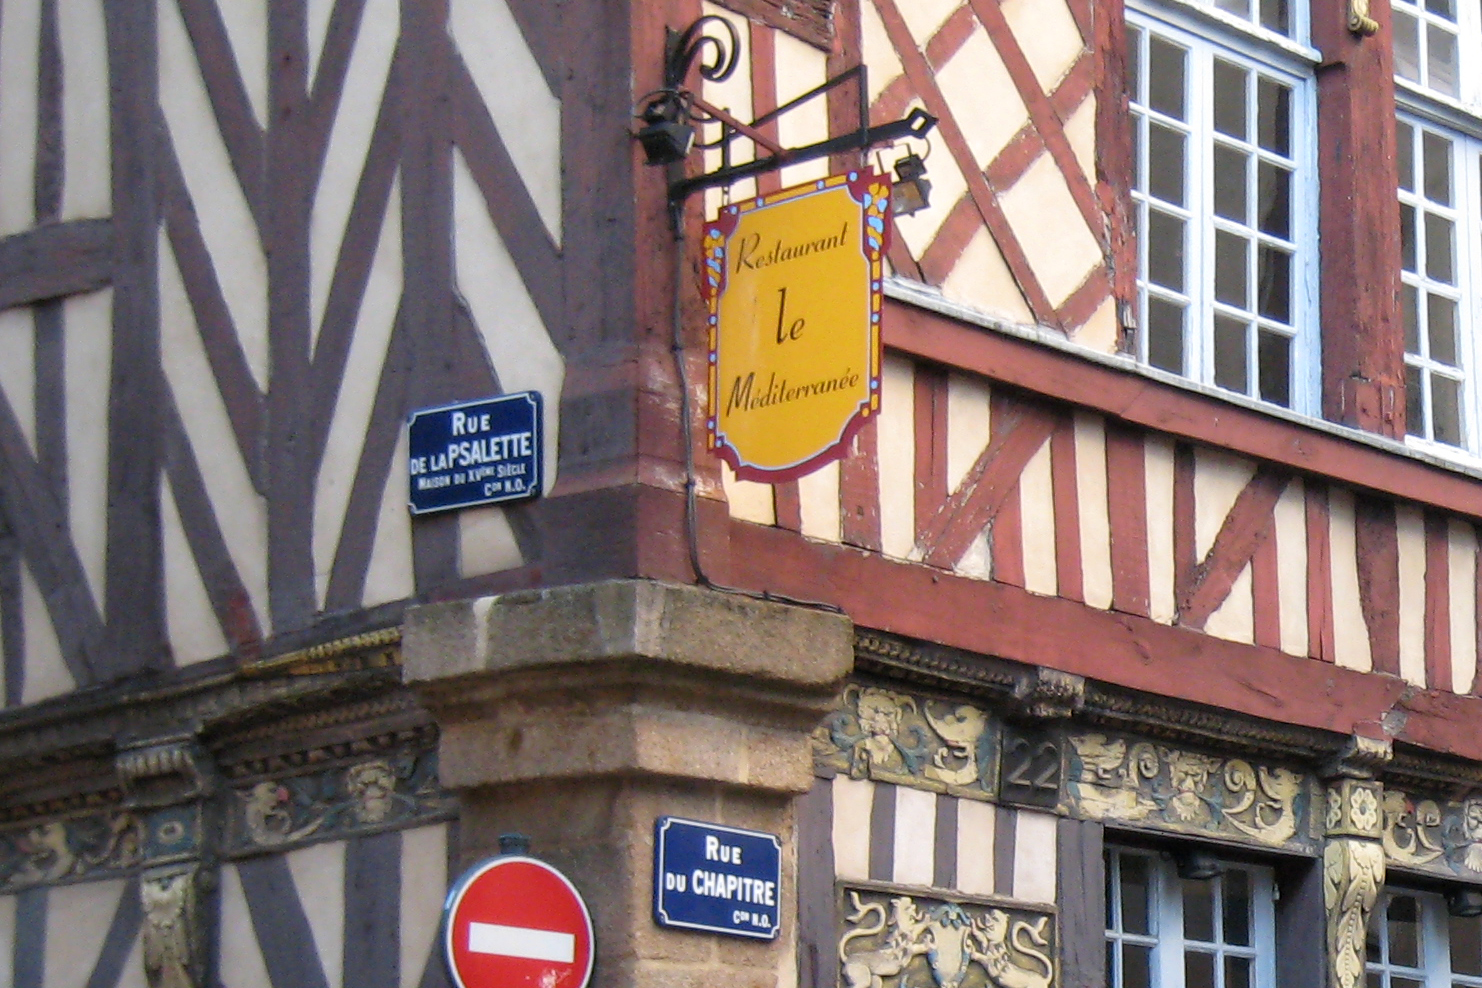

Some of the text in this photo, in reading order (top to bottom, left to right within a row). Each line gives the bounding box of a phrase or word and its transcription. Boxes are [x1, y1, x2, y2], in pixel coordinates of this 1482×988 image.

[736, 222, 848, 274] Restaurant
[726, 368, 860, 418] Méditerranée
[453, 411, 491, 436] RUE
[411, 432, 532, 476] DE LA PSALETTE
[1006, 738, 1058, 790] 22
[705, 835, 742, 865] RUE
[666, 869, 776, 907] DU CHAPITRE
